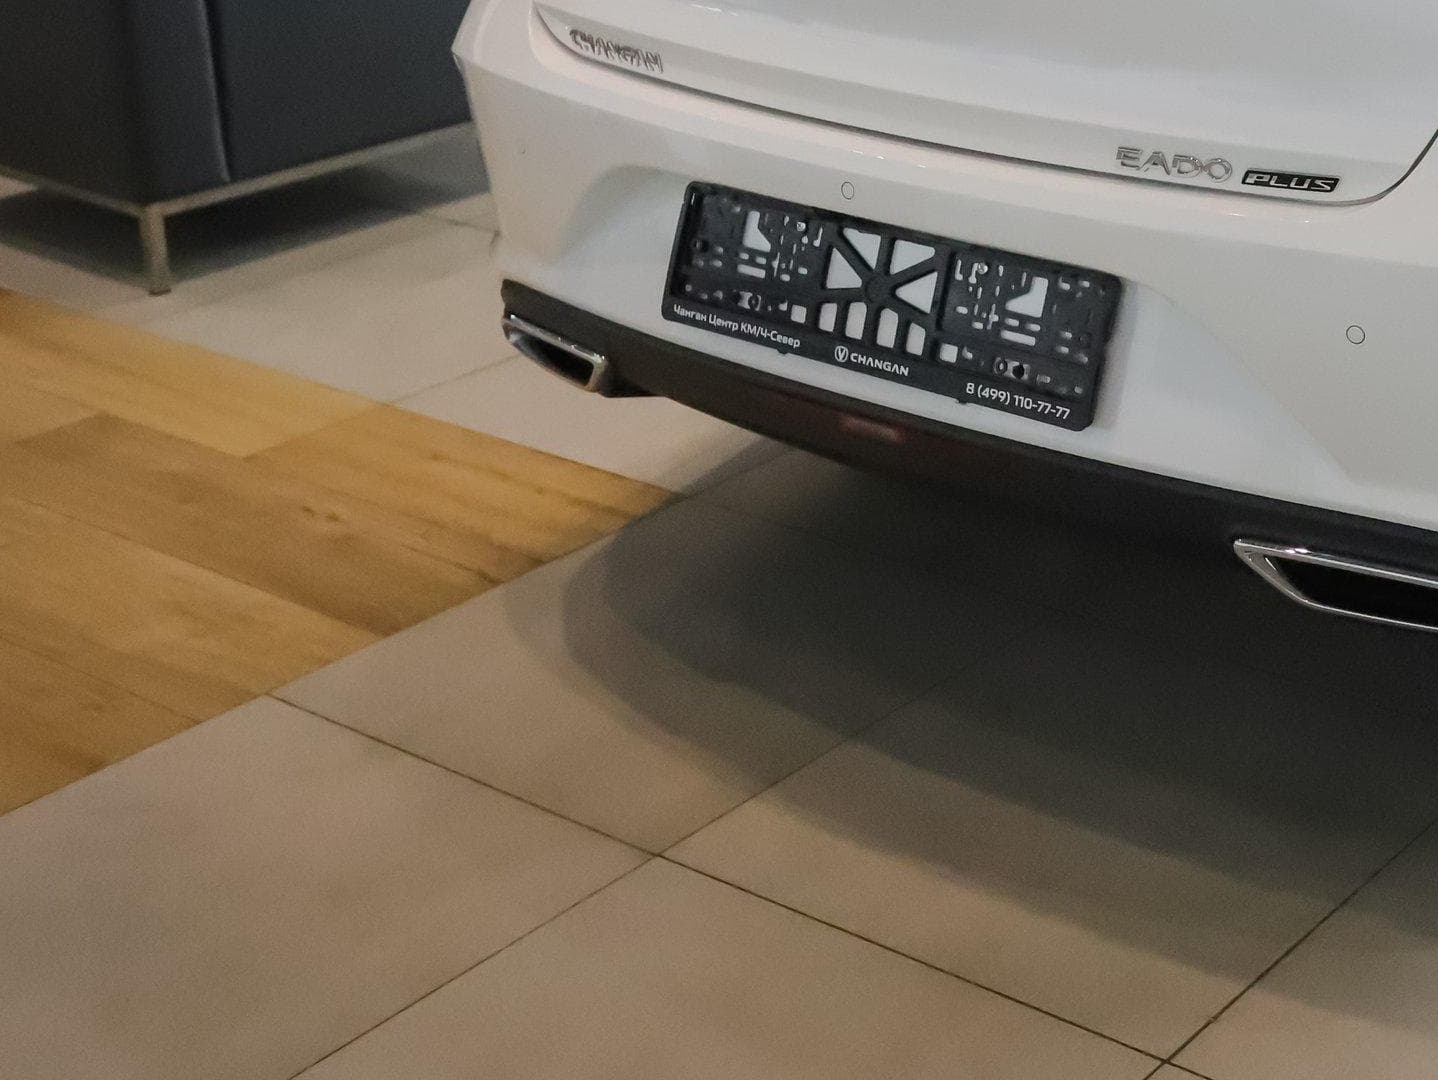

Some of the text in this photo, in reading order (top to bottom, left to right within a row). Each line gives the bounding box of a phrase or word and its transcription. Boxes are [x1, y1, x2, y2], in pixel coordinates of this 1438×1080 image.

[1116, 146, 1338, 192] EADO PLUS
[673, 304, 707, 321] Чанган
[709, 314, 739, 331] Центр
[849, 352, 910, 377] CHANGAN
[965, 382, 1071, 420] 8 (499) 110-77-77
